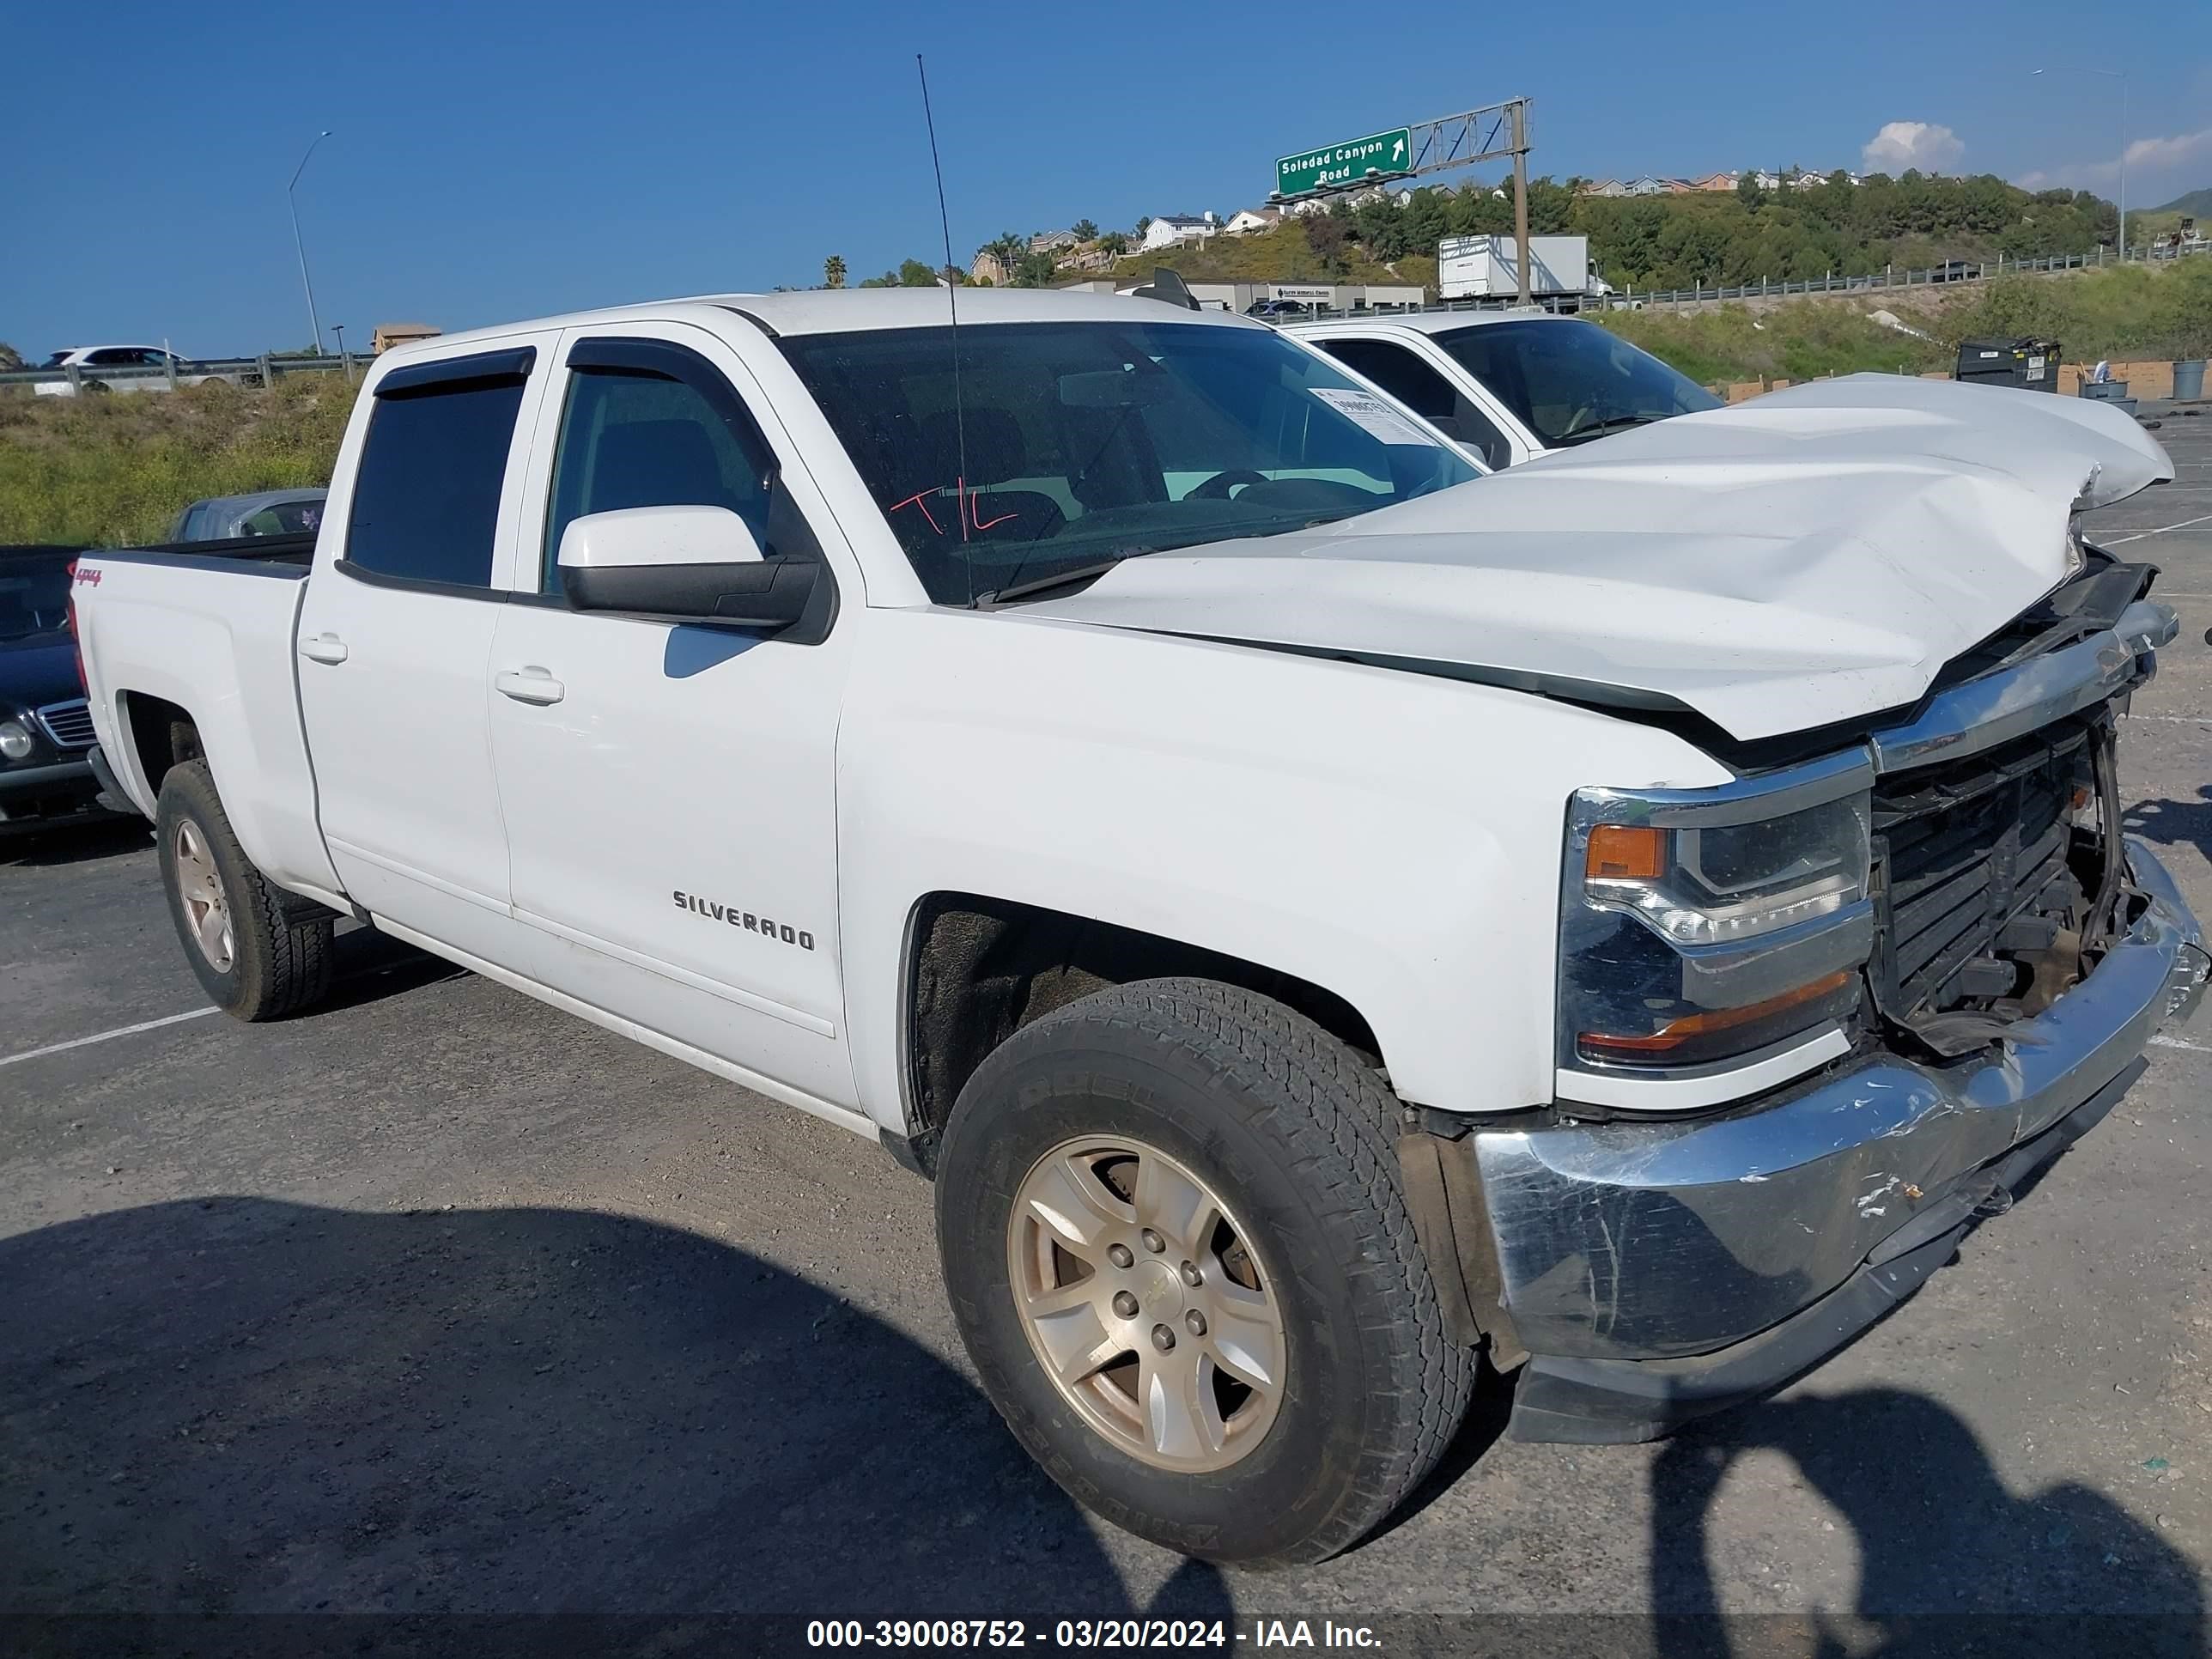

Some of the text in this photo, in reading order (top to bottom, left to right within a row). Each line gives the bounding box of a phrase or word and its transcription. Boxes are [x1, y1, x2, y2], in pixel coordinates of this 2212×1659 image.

[1282, 142, 1383, 175] Soledad Canyon
[1320, 165, 1351, 183] Road
[673, 890, 815, 951] SILVERADO
